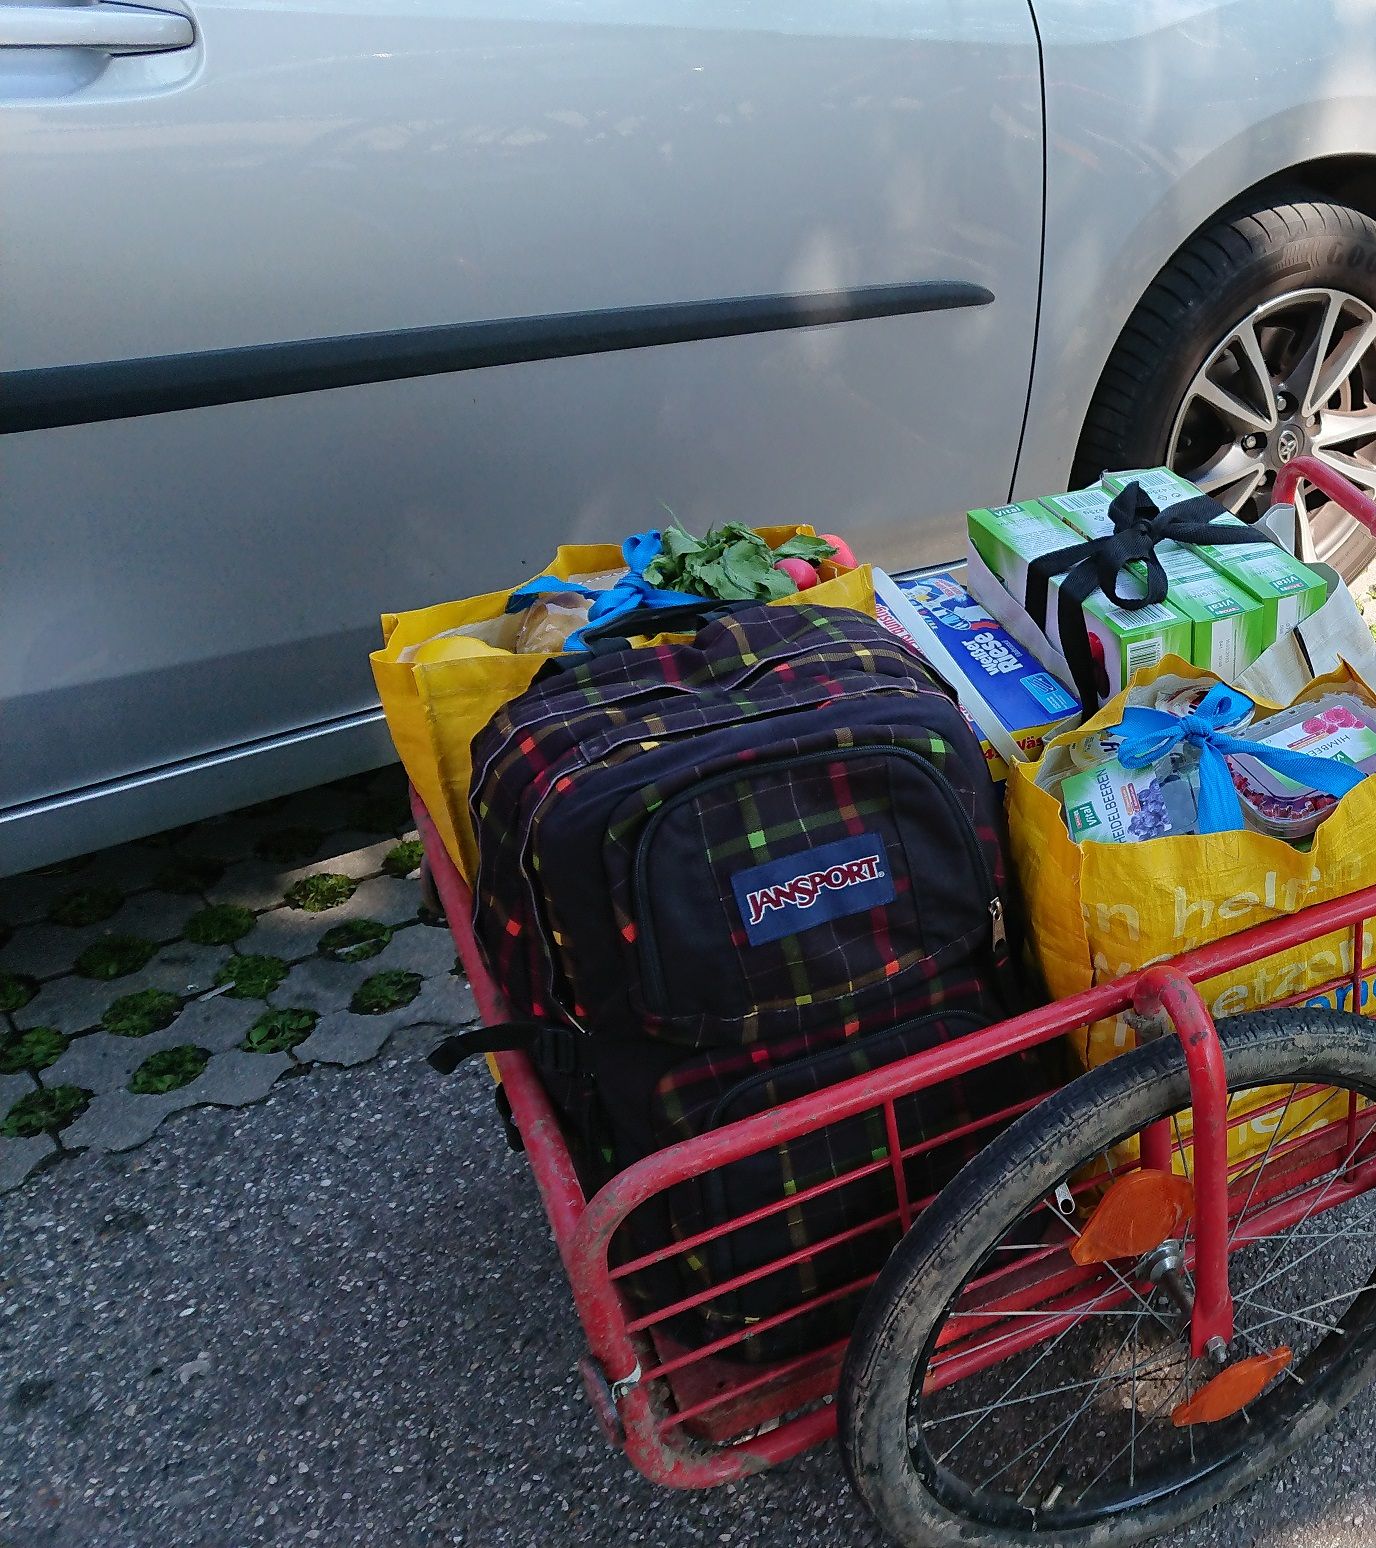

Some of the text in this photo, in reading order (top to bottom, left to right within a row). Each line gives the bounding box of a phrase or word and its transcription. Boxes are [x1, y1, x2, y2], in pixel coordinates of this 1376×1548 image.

[995, 506, 1021, 517] Vital
[1273, 576, 1298, 588] Vital
[1207, 599, 1235, 612] Vital
[961, 640, 1000, 676] Weißer
[974, 632, 1024, 674] Riese
[1079, 802, 1098, 826] Vital
[1095, 768, 1127, 844] HEIDELBEEREN
[747, 855, 880, 925] JANSPORT
